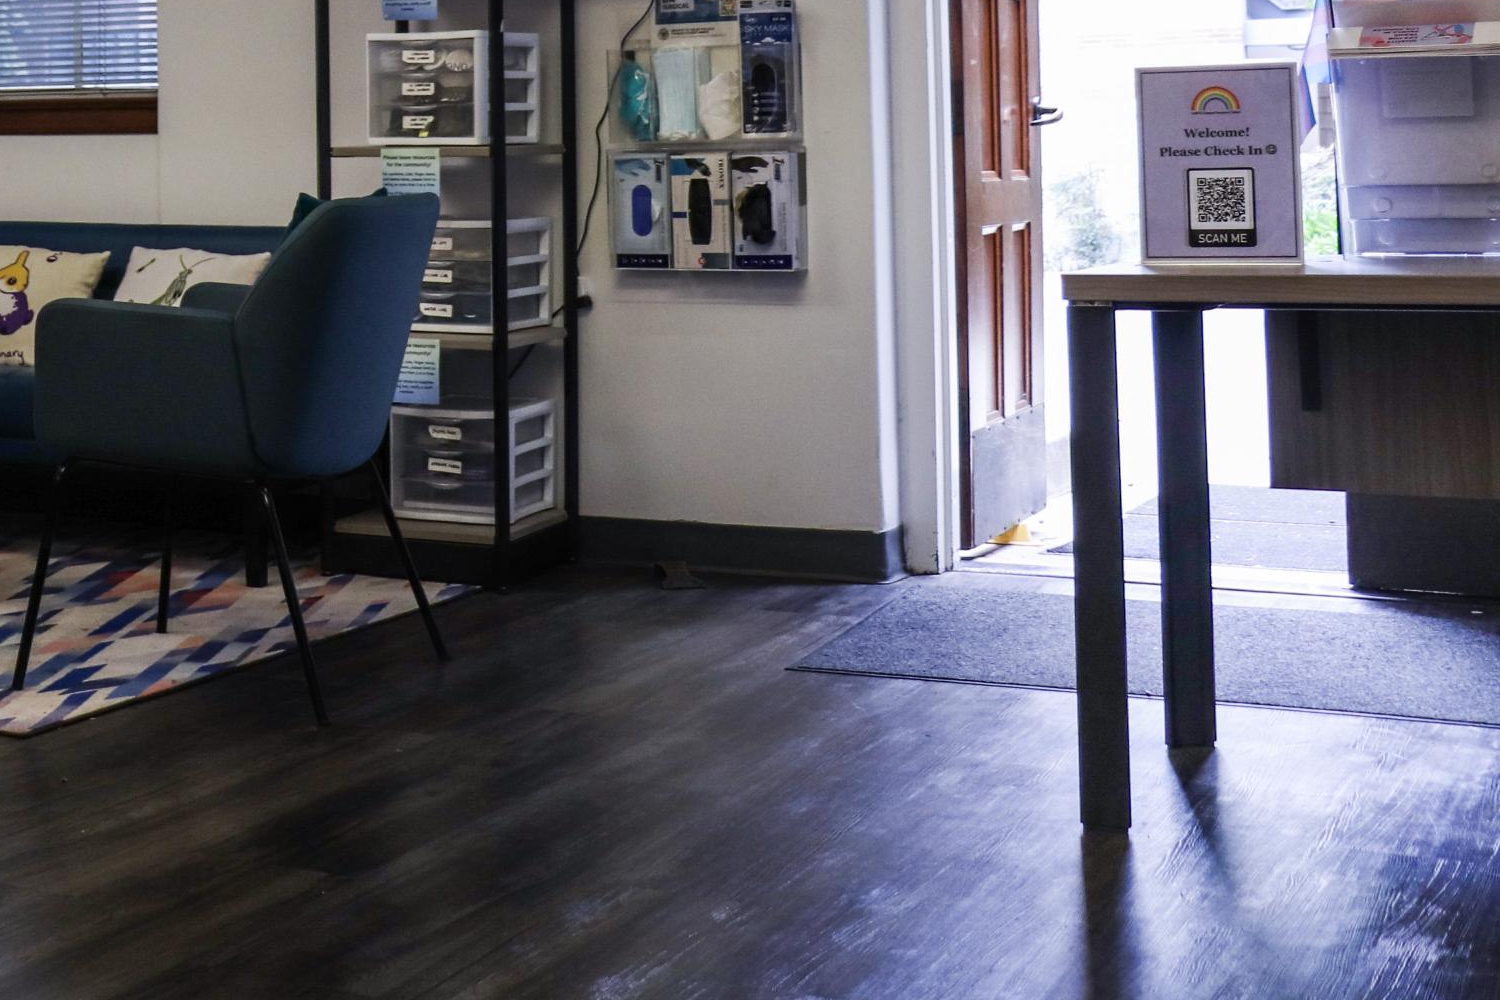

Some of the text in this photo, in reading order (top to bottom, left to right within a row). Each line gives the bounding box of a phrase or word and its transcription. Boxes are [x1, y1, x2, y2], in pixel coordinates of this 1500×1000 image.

[1184, 127, 1251, 138] Welcome!
[1159, 145, 1263, 157] Please Check In
[1198, 233, 1247, 243] SCAN ME
